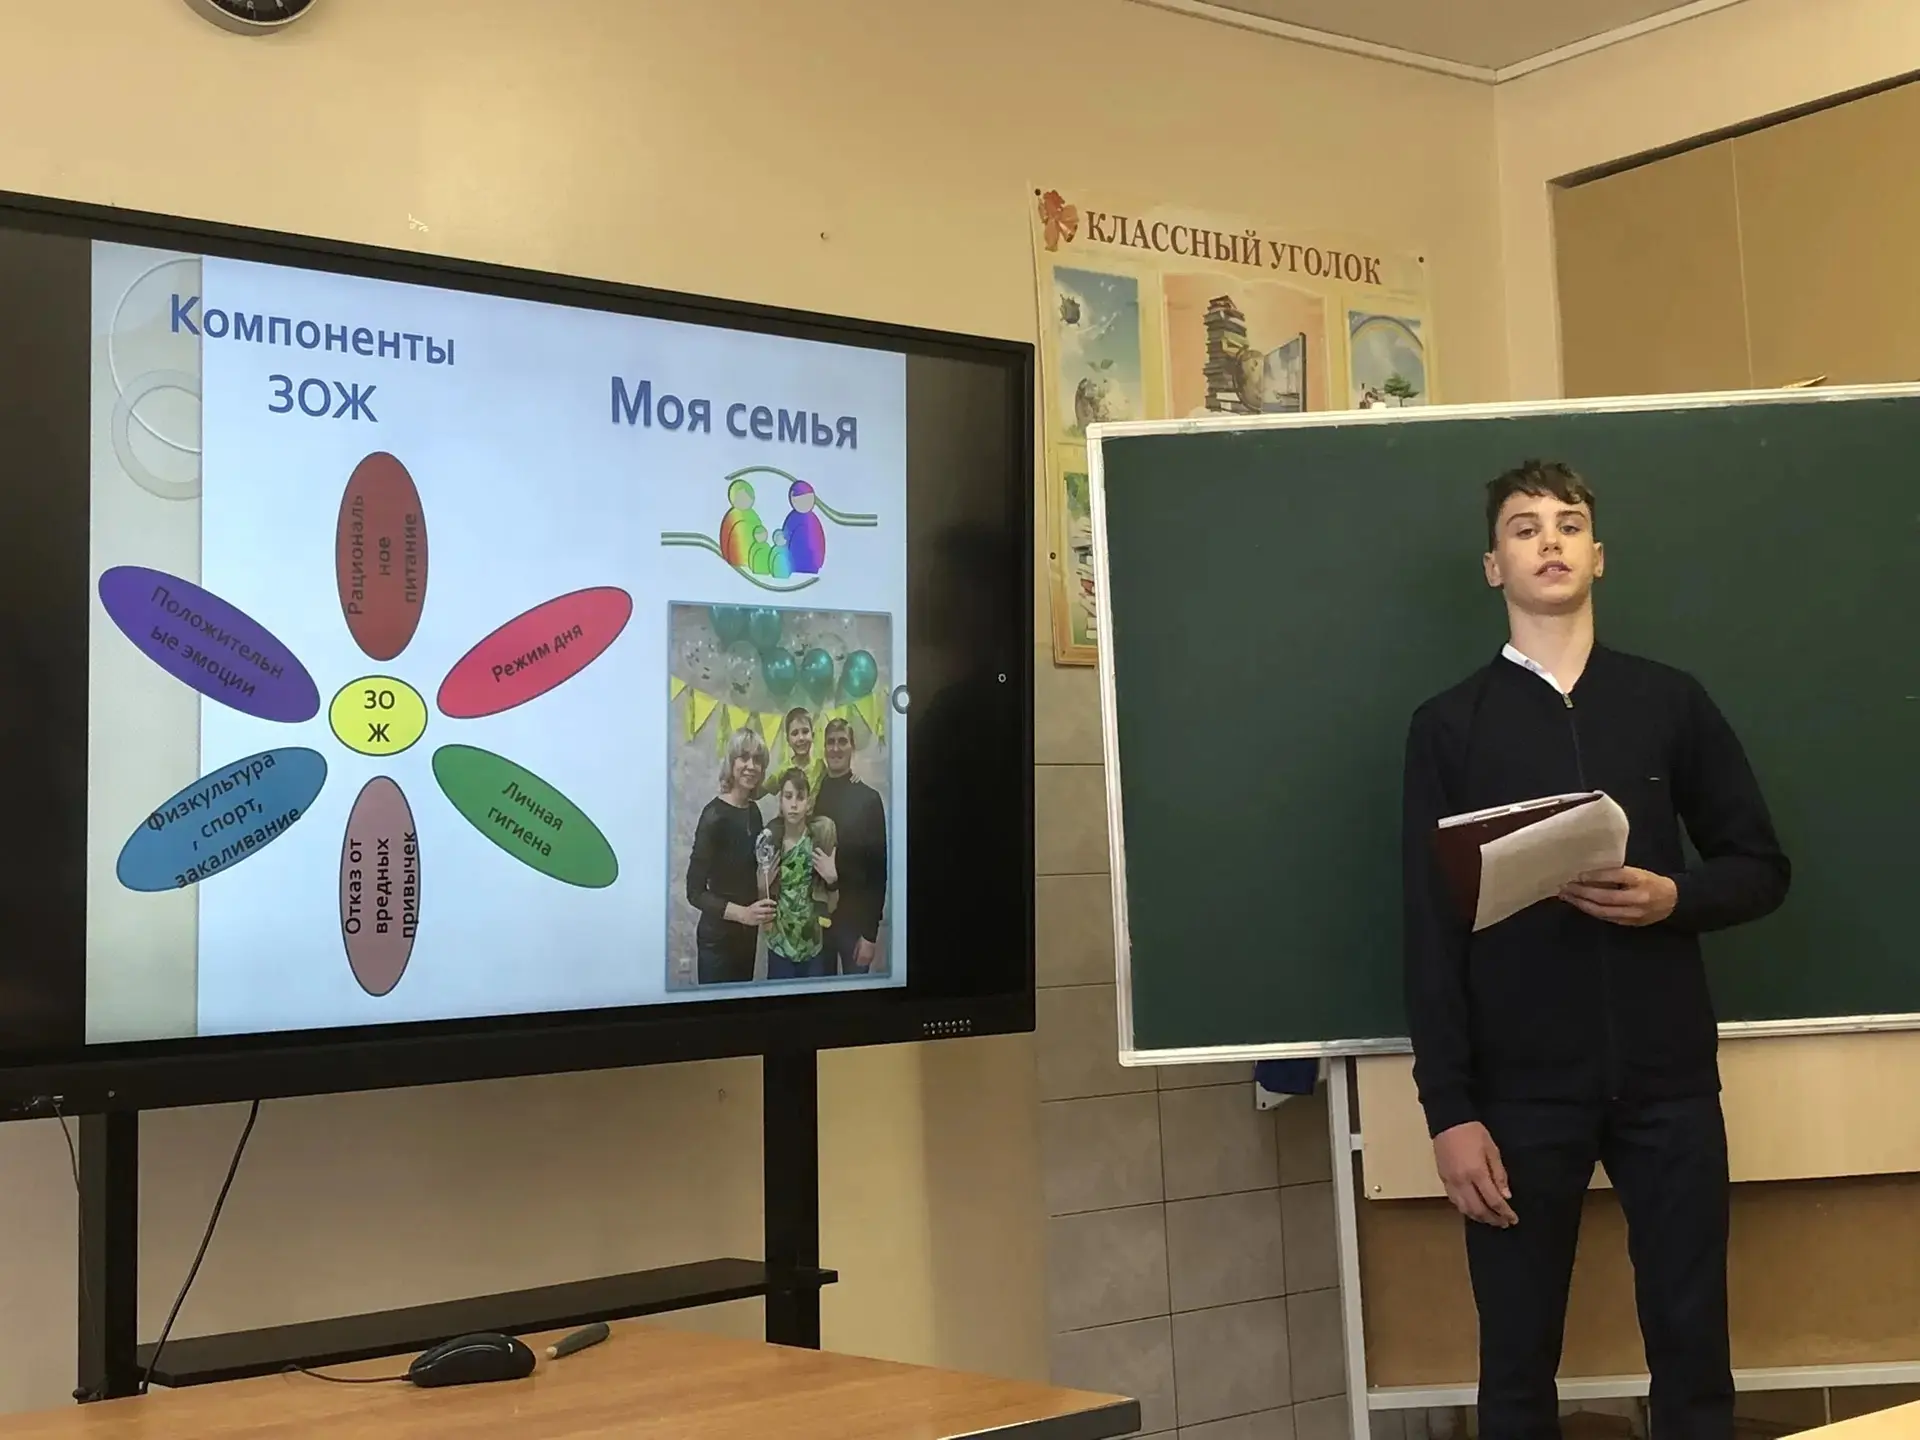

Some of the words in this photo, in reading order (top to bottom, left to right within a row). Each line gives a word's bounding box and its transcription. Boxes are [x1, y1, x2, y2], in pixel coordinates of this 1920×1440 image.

[1086, 211, 1262, 267] КЛАССНЫЙ
[1269, 241, 1382, 285] УГОЛОК
[171, 294, 455, 366] Компоненты
[268, 374, 378, 423] ЗОЖ
[611, 376, 711, 434] Моя
[726, 402, 857, 449] семья
[348, 495, 367, 616] Рациональ
[379, 536, 391, 576] ное
[405, 513, 418, 603] питание
[151, 586, 284, 680] Положительн
[151, 625, 179, 651] ые
[181, 644, 256, 698] эмоции
[491, 642, 551, 683] Режим
[554, 624, 584, 653] дня
[364, 689, 395, 710] ЗО
[367, 723, 390, 742] Ж
[147, 754, 276, 832] Физкультура
[201, 798, 263, 839] спорт,
[502, 781, 563, 831] Личная
[175, 808, 301, 888] закаливание
[350, 838, 363, 862] от
[487, 806, 552, 857] гигиена
[345, 869, 363, 935] Отказ
[376, 838, 393, 934] вредных
[402, 832, 419, 938] привычек
